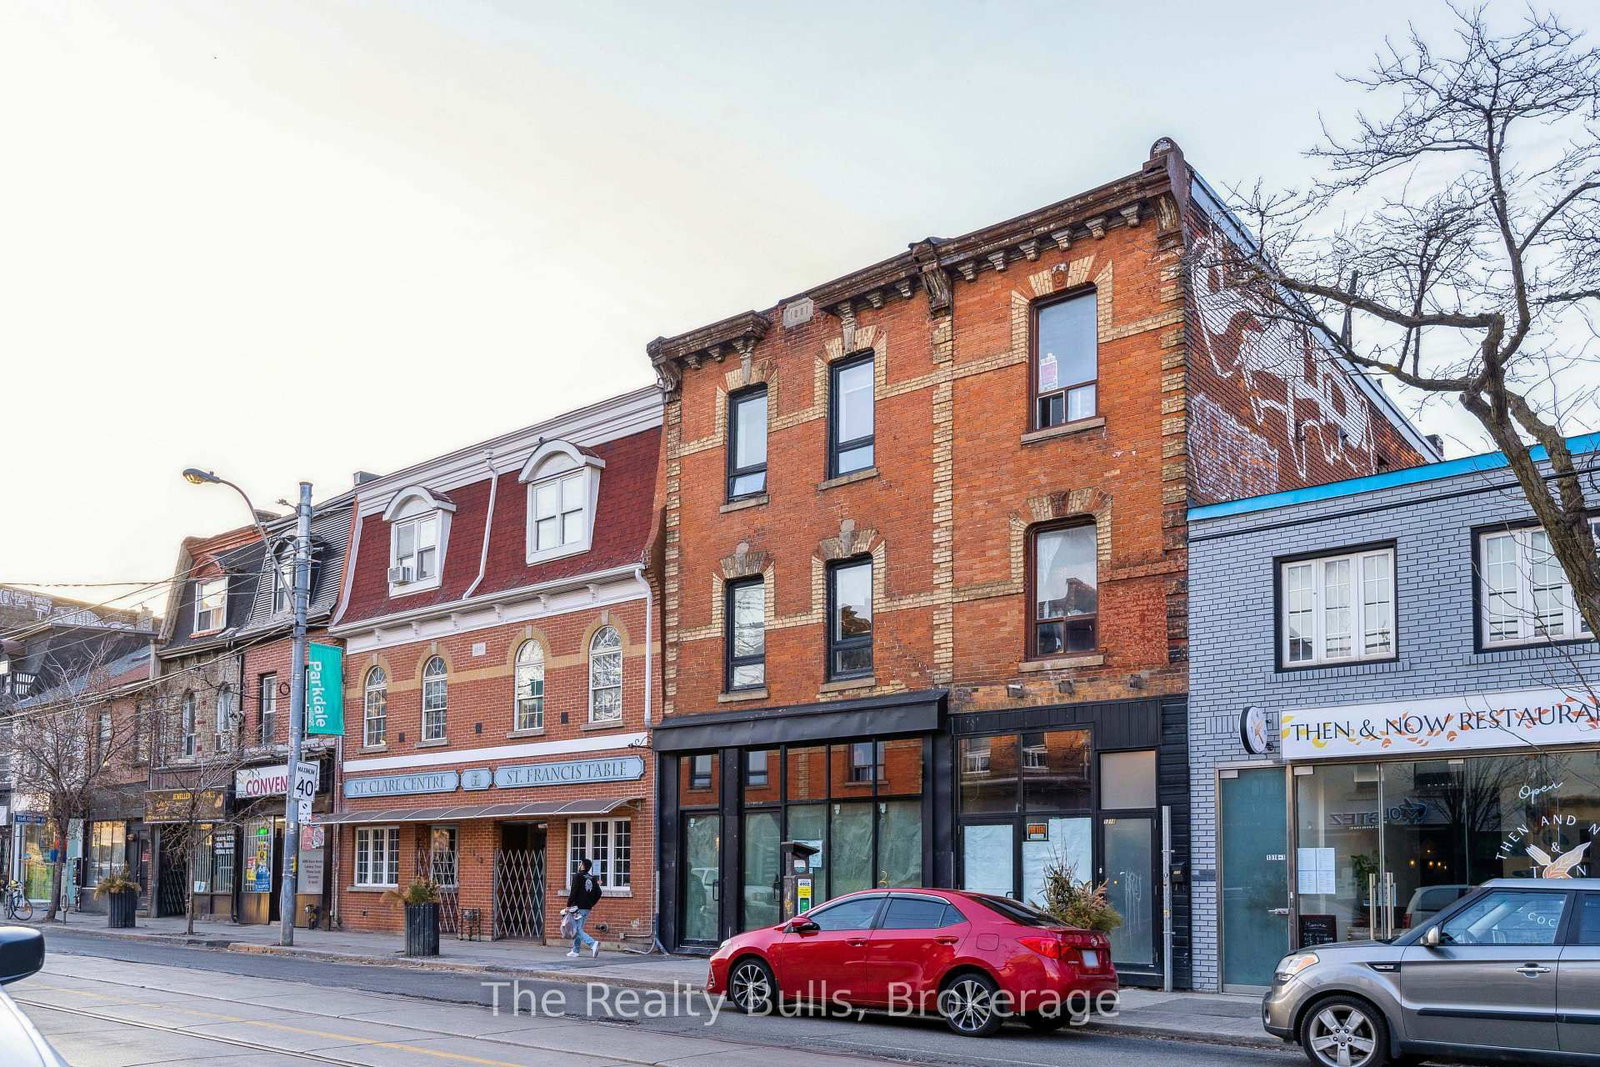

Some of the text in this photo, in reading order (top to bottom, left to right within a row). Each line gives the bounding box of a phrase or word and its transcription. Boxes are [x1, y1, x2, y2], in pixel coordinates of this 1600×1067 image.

[309, 661, 328, 728] Parkdale
[1290, 720, 1350, 741] THEN
[1359, 719, 1382, 740] &
[1385, 713, 1452, 736] NOW
[354, 774, 446, 794] ST. CLARE CENTRE
[506, 761, 627, 784] ST. FRANCIS TABLE
[246, 775, 288, 796] CONVEN
[296, 778, 313, 797] 40
[1518, 781, 1564, 805] Open
[1495, 824, 1530, 860] THEN
[1541, 814, 1577, 826] AND
[1576, 864, 1587, 876] N
